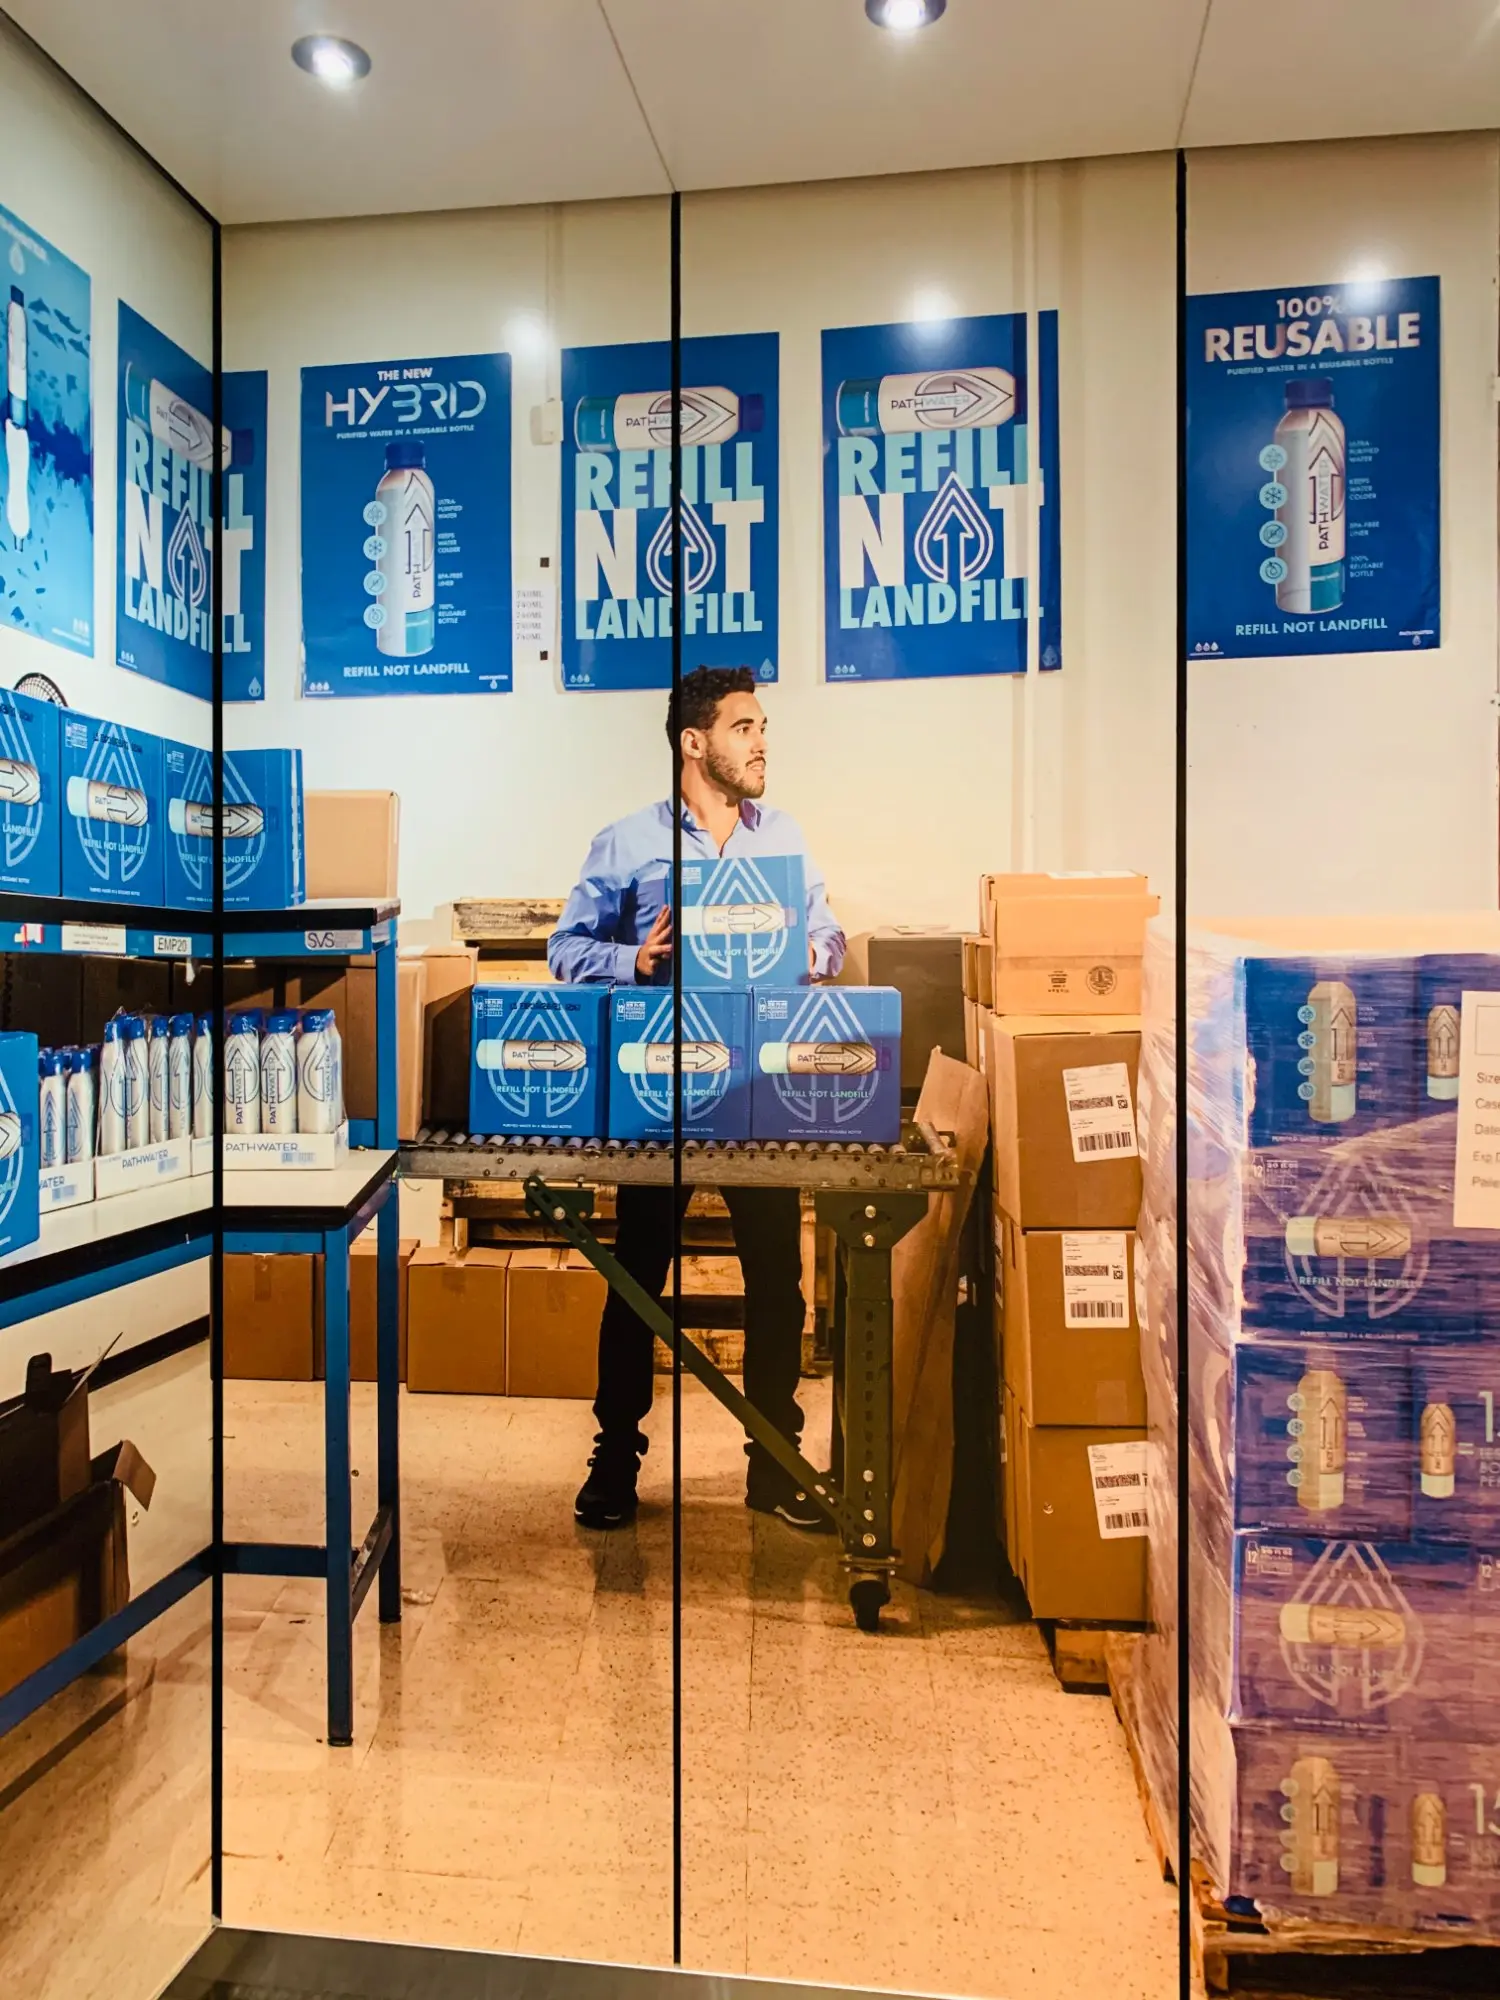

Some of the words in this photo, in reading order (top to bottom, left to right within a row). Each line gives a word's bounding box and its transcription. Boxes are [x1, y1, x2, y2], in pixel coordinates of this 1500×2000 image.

[1204, 312, 1420, 362] REUSABLE
[377, 369, 400, 381] THE
[403, 367, 433, 379] NEW
[325, 380, 487, 427] HYBRID
[838, 424, 1044, 496] REFILL
[1235, 623, 1278, 636] REFILL
[1283, 621, 1315, 634] NOT
[1320, 617, 1388, 632] LANDFILL
[343, 666, 380, 678] REFILL
[383, 664, 410, 676] NOT
[414, 662, 470, 675] LANDFILL
[158, 938, 187, 952] EMP20
[307, 931, 335, 948] SVS
[512, 1051, 535, 1059] PATH
[496, 1085, 520, 1093] REFILL
[543, 1086, 579, 1094] LANDFILL
[781, 1090, 806, 1098] REFILL
[809, 1090, 827, 1098] NOT
[830, 1090, 869, 1098] LANDFILL
[225, 1142, 298, 1152] PATHWATER
[122, 1149, 168, 1169] PATHWATER
